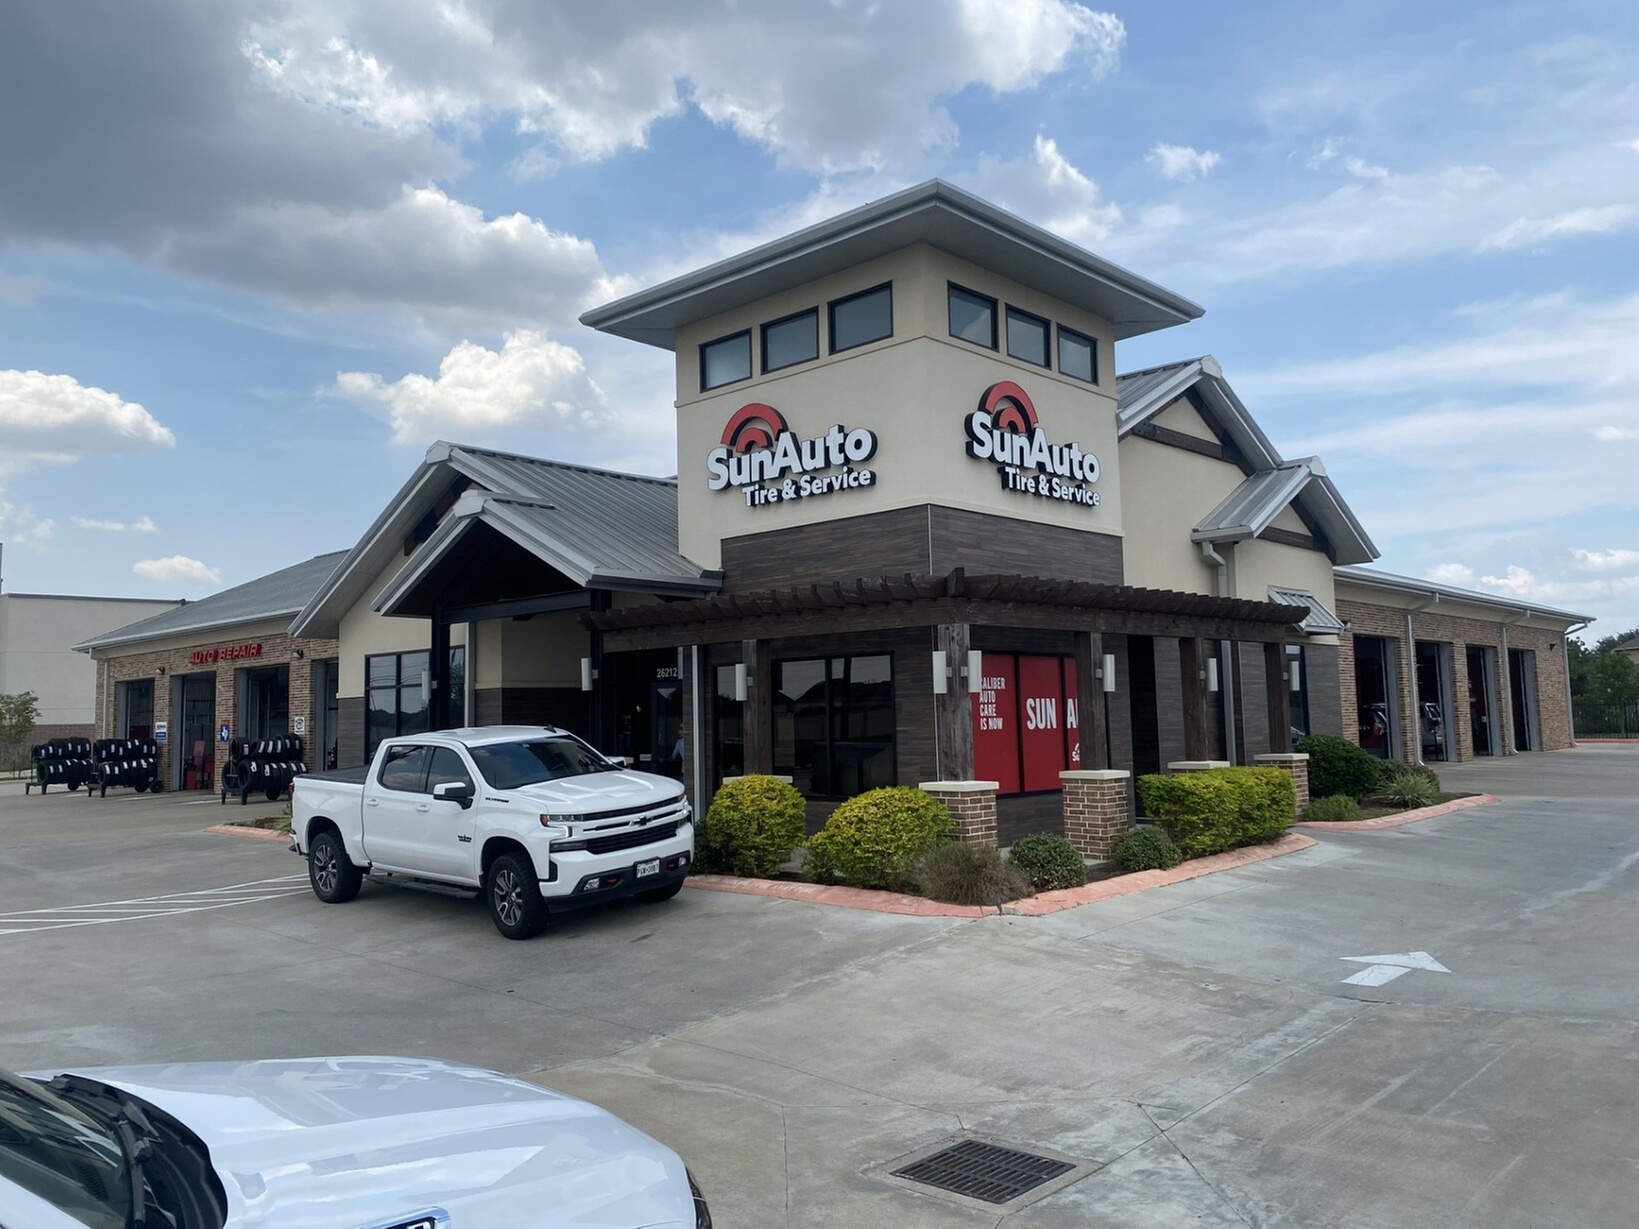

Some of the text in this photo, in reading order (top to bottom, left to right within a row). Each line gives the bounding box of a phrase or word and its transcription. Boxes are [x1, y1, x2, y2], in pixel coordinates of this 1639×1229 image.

[742, 466, 872, 506] Tire & Service
[1004, 467, 1101, 506] Tire & Service
[189, 643, 259, 663] AUTO REPAIR
[656, 667, 678, 678] 26212
[981, 677, 1006, 690] ALIBER
[979, 691, 996, 703] AUTO
[979, 704, 997, 717] CARE
[1026, 698, 1057, 730] SUN
[980, 717, 1003, 730] IS NOW
